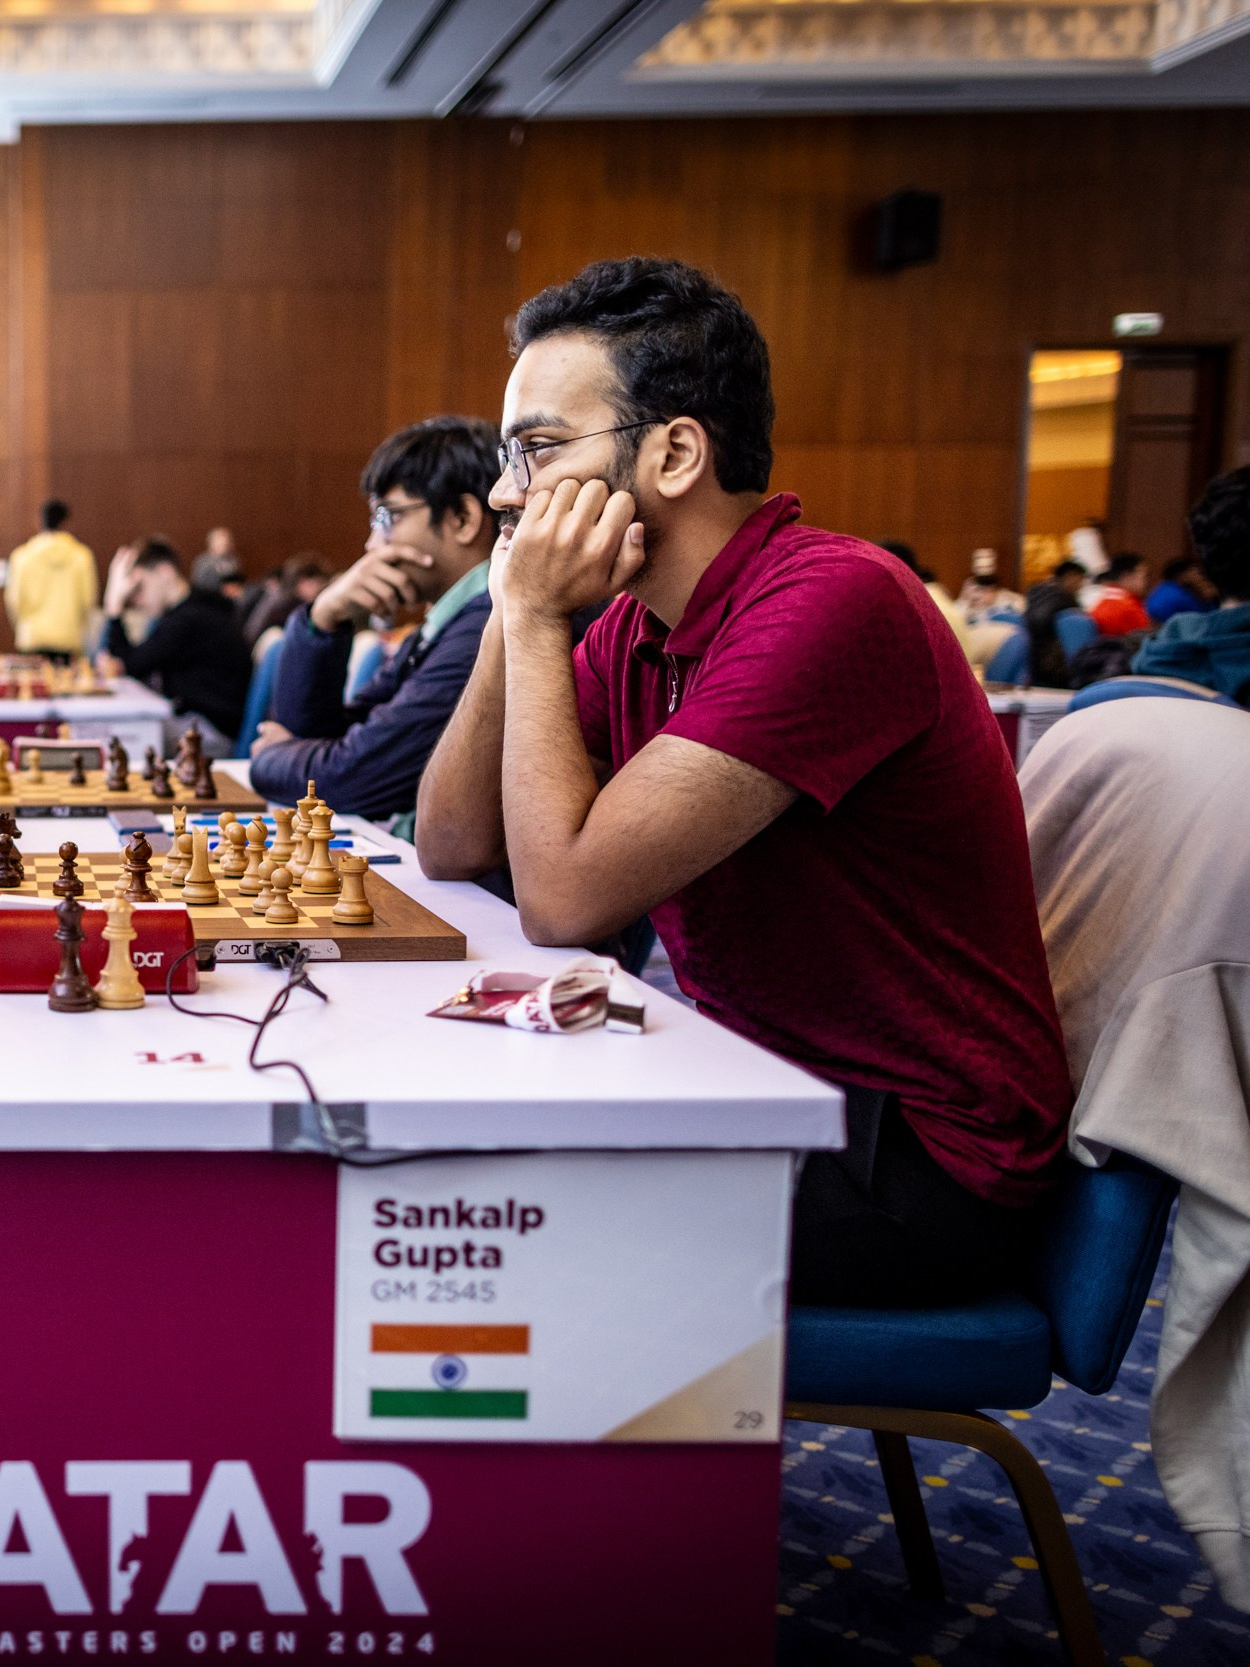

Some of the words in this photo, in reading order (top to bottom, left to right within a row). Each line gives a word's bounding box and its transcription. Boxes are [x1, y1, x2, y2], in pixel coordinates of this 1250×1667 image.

[133, 951, 165, 967] DGT
[231, 944, 252, 955] DGT
[134, 1051, 206, 1065] 14
[373, 1198, 545, 1235] Sankalp
[373, 1239, 503, 1274] Gupta
[371, 1280, 417, 1302] GM
[427, 1280, 496, 1303] 2545
[732, 1410, 764, 1430] 29
[187, 1630, 297, 1654] OPEN
[327, 1630, 435, 1655] 2024
